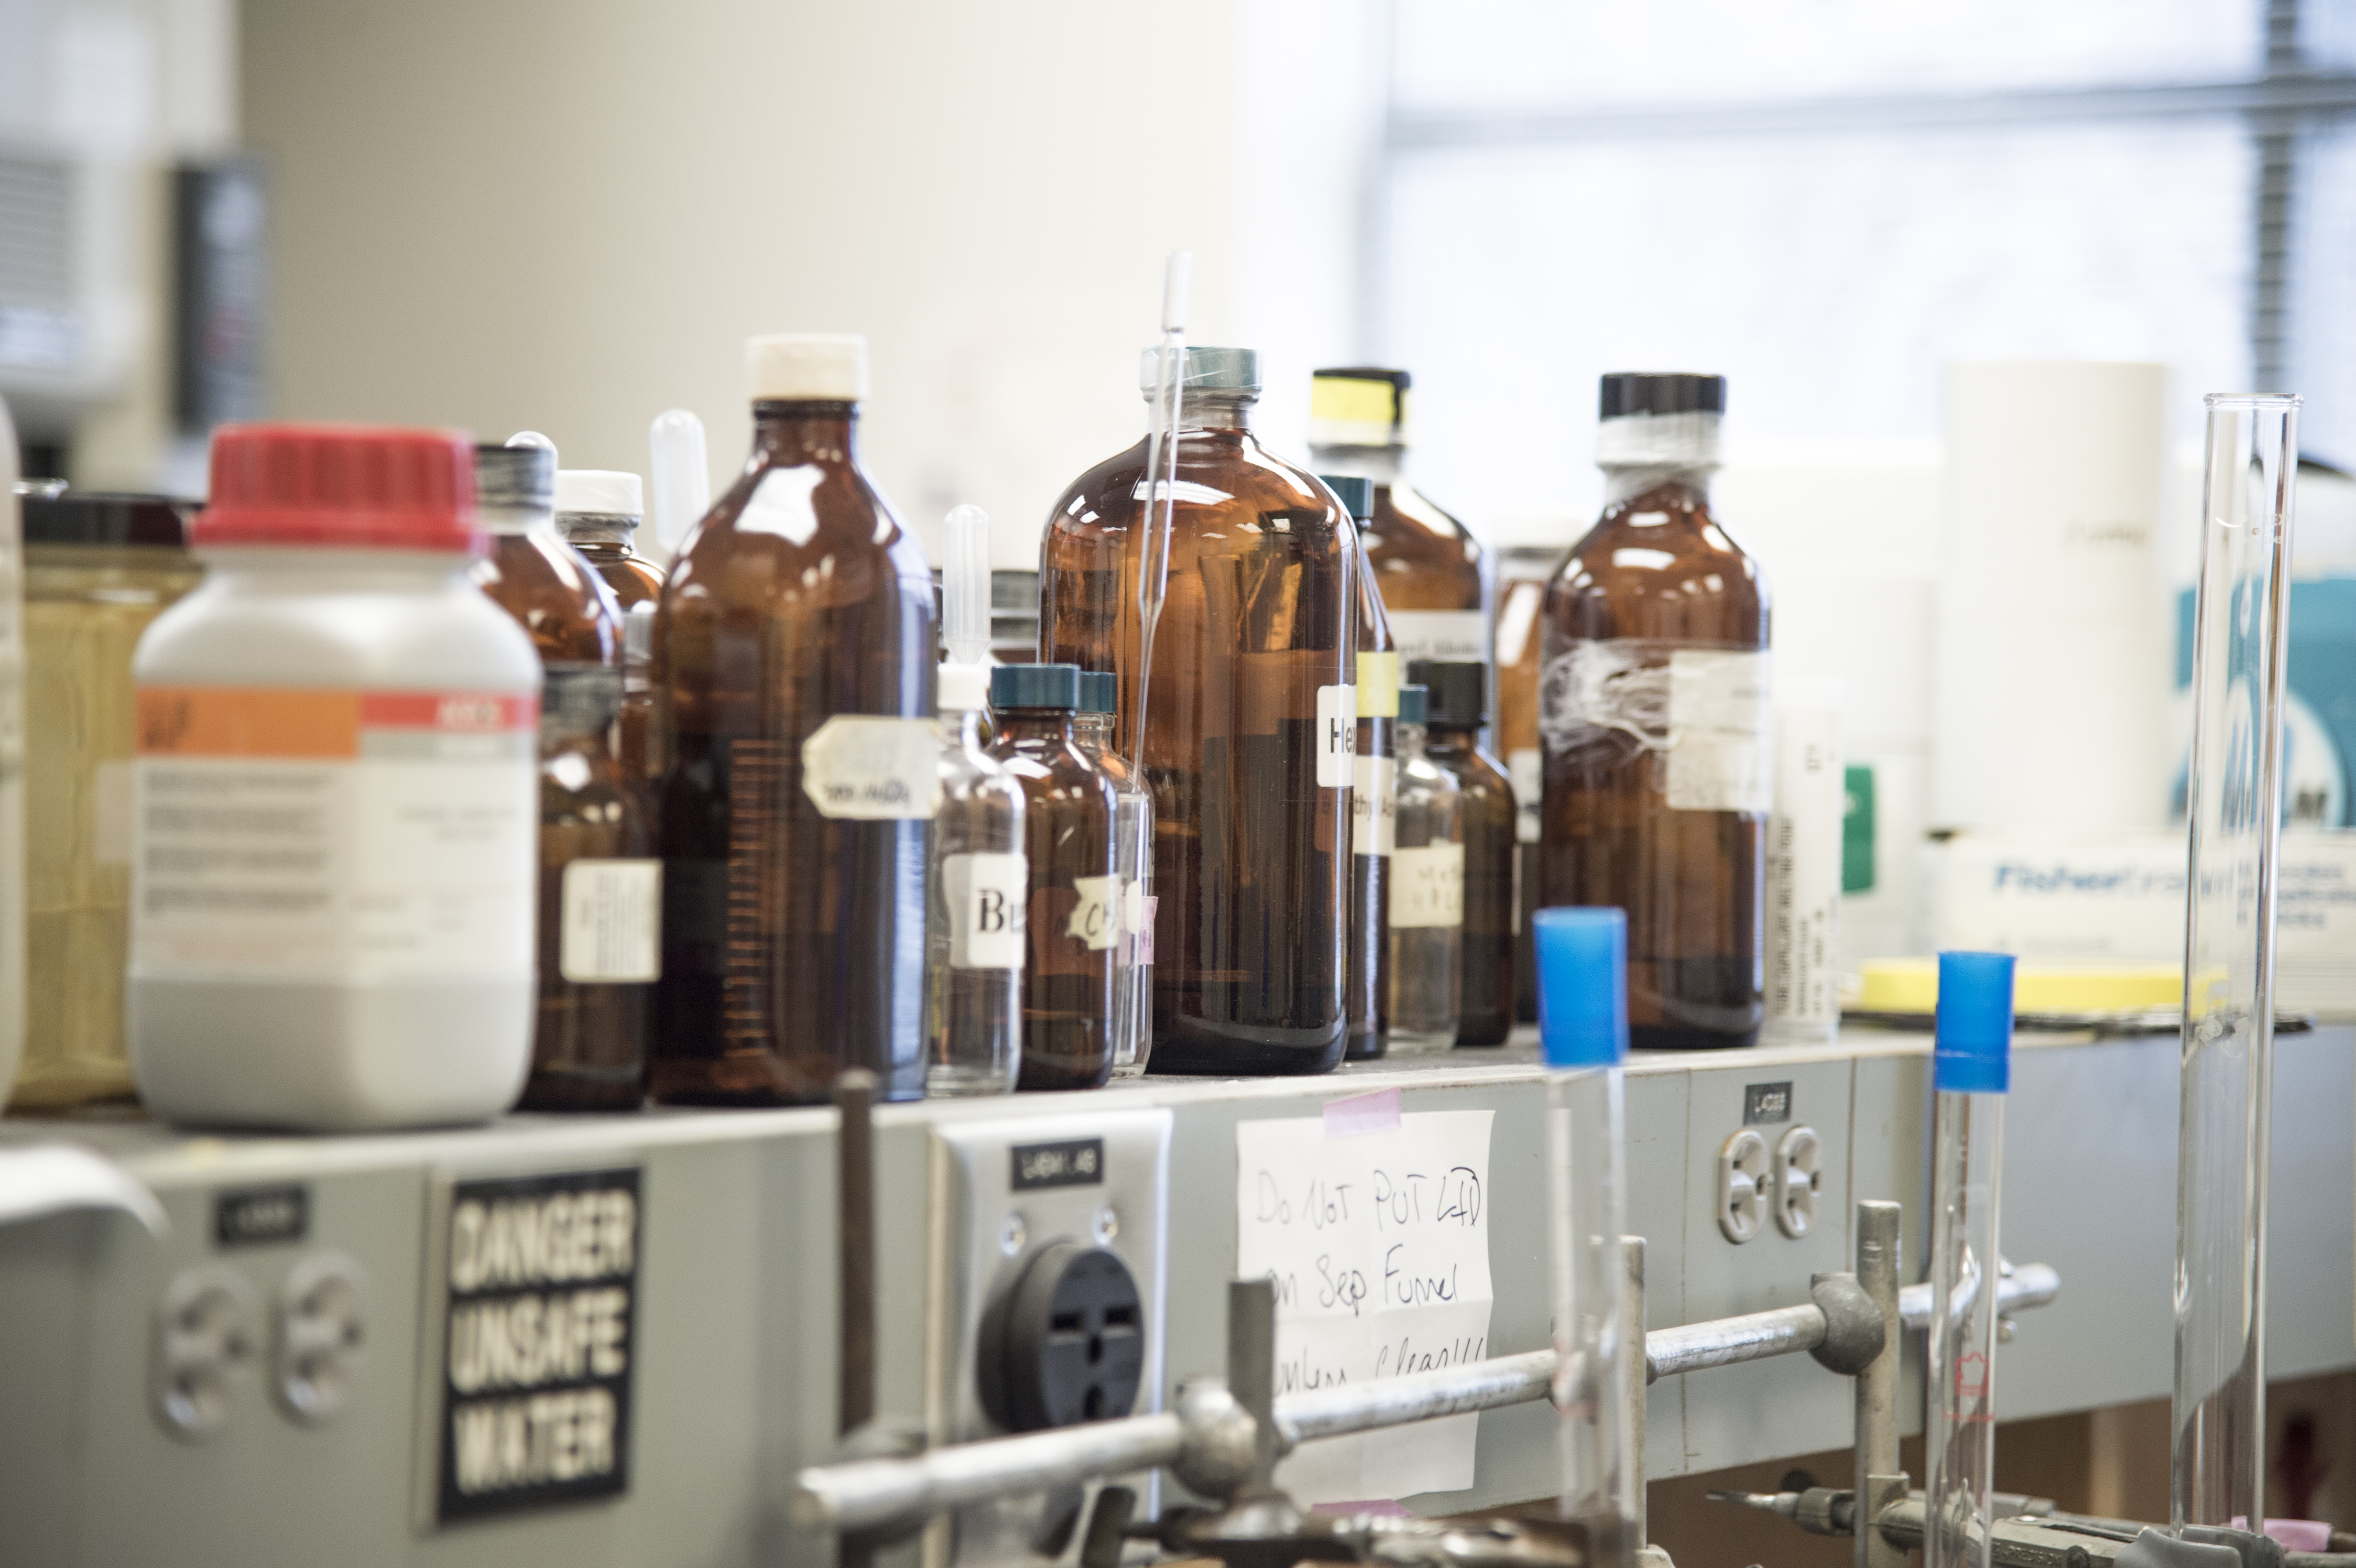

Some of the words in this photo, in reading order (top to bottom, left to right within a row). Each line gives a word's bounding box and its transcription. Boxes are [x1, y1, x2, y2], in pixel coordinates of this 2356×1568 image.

[452, 1188, 636, 1292] DANGER
[451, 1285, 627, 1393] UNSAFE
[453, 1386, 616, 1495] WATER
